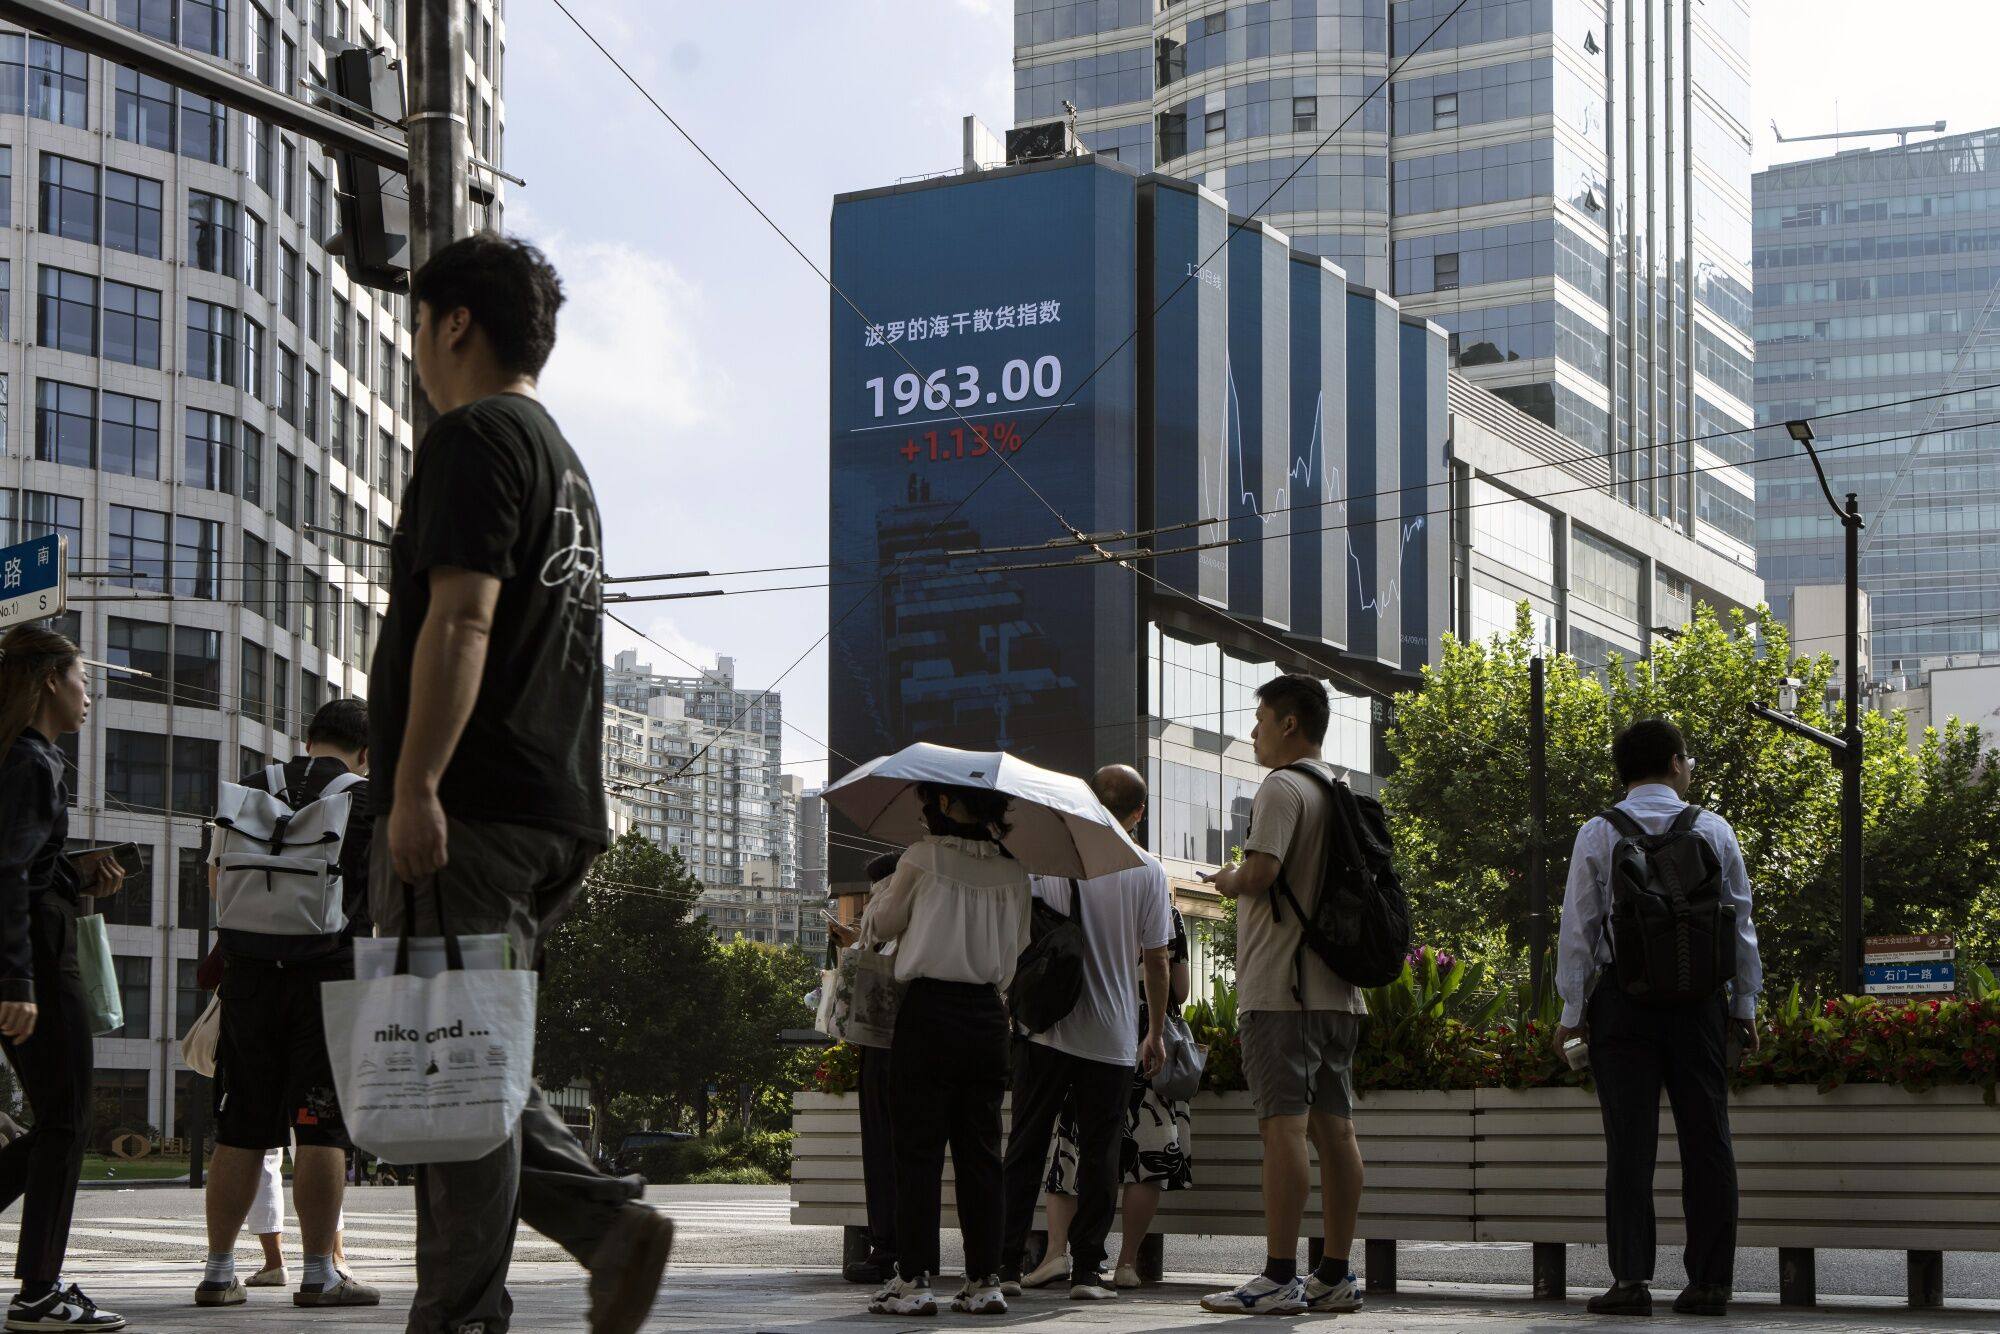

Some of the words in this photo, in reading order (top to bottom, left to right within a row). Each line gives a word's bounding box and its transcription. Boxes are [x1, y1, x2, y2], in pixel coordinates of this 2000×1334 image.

[864, 300, 1061, 347] 波罗的海干散货指数
[865, 355, 1062, 418] 1963.00
[900, 421, 1023, 463] +1.13%
[37, 546, 50, 566] 南
[39, 595, 47, 610] S
[1884, 969, 1932, 980] 石门一路
[374, 1024, 420, 1043] niko
[425, 1019, 463, 1044] and
